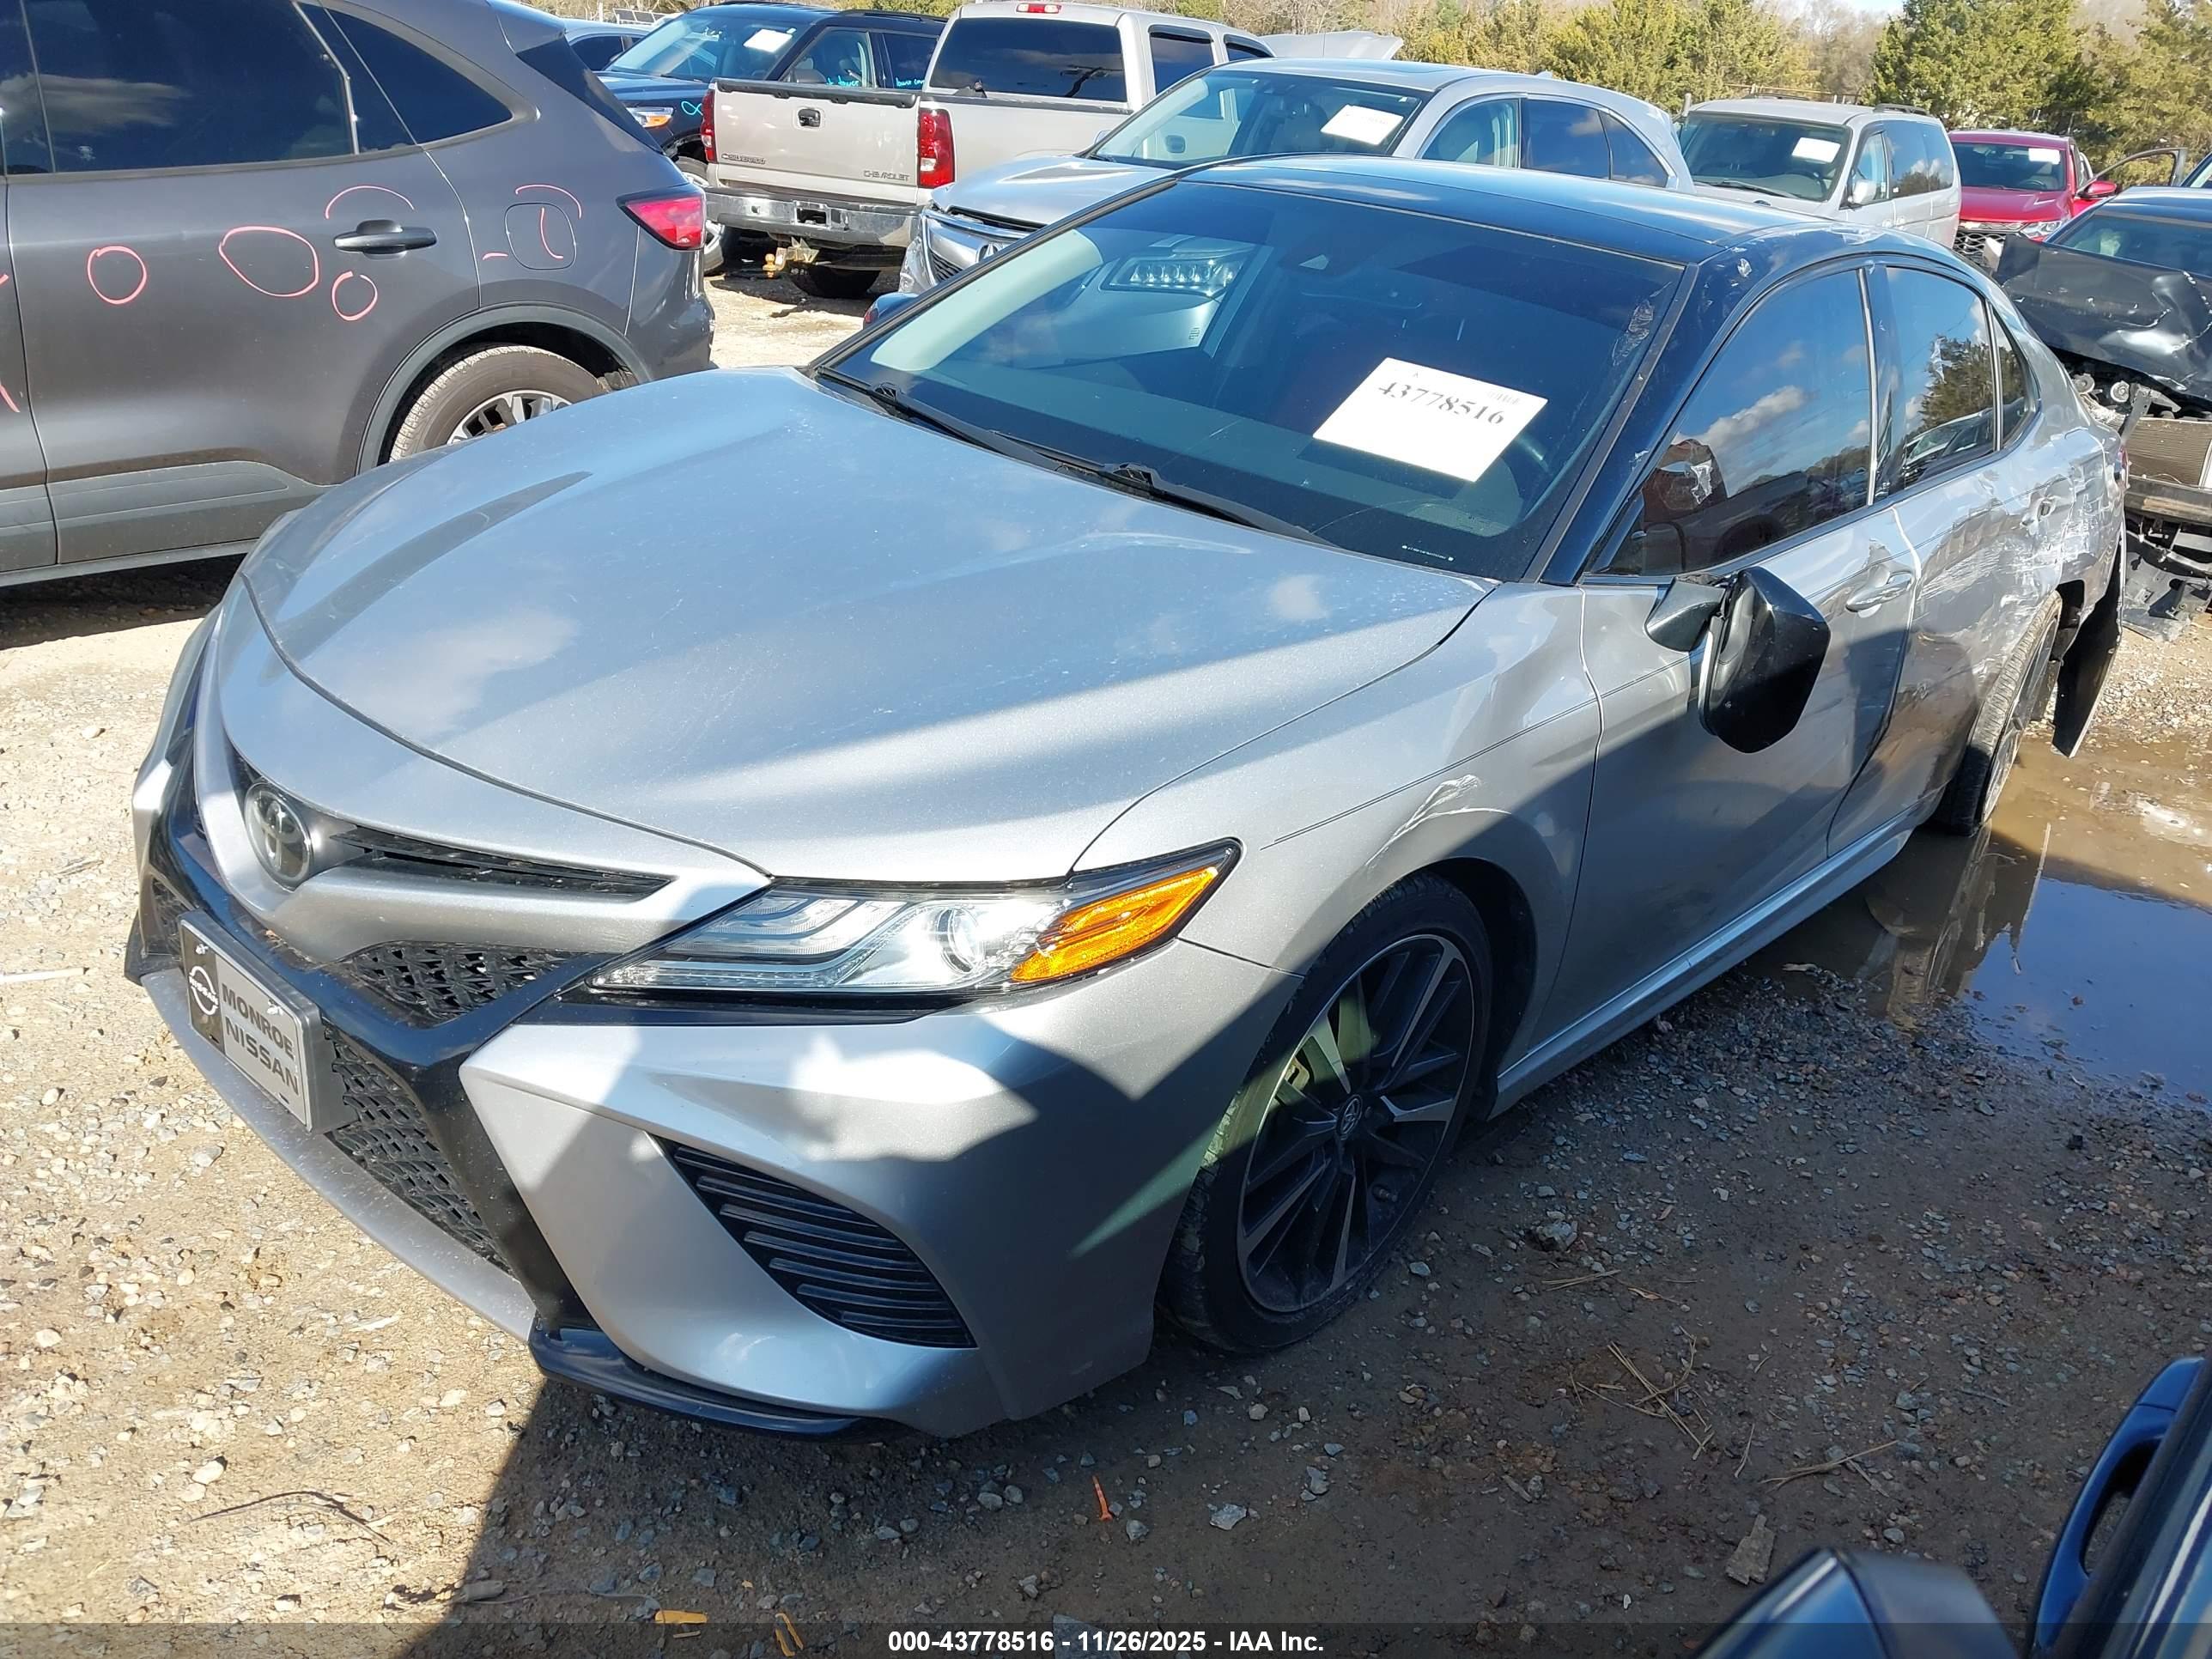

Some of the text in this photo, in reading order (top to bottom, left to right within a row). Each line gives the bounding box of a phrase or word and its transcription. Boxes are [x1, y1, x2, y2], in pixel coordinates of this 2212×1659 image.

[863, 170, 910, 182] CHEVROLET
[1378, 381, 1504, 424] 43778516
[222, 982, 295, 1060] MONROE
[225, 1016, 300, 1096] NISSAN
